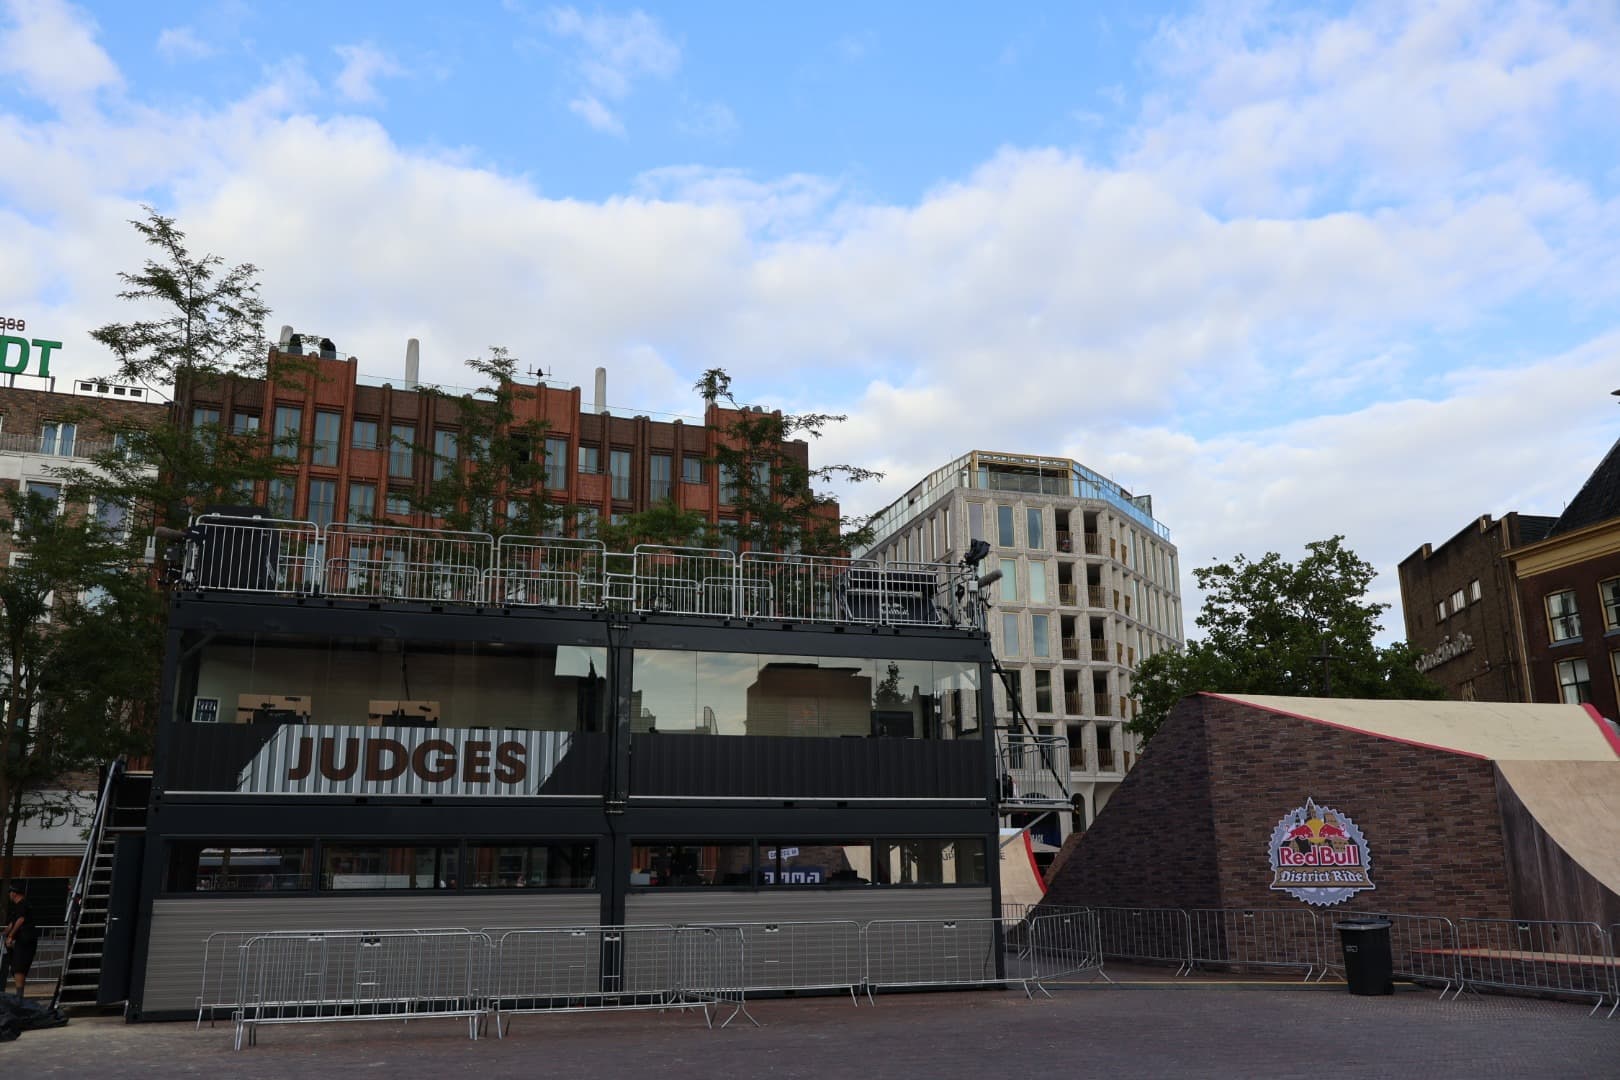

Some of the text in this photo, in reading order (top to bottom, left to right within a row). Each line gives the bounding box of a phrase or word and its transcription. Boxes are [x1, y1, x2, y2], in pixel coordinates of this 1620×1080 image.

[288, 737, 527, 784] JUDGES
[1280, 845, 1359, 865] Red Bull
[1281, 871, 1364, 882] District Ride
